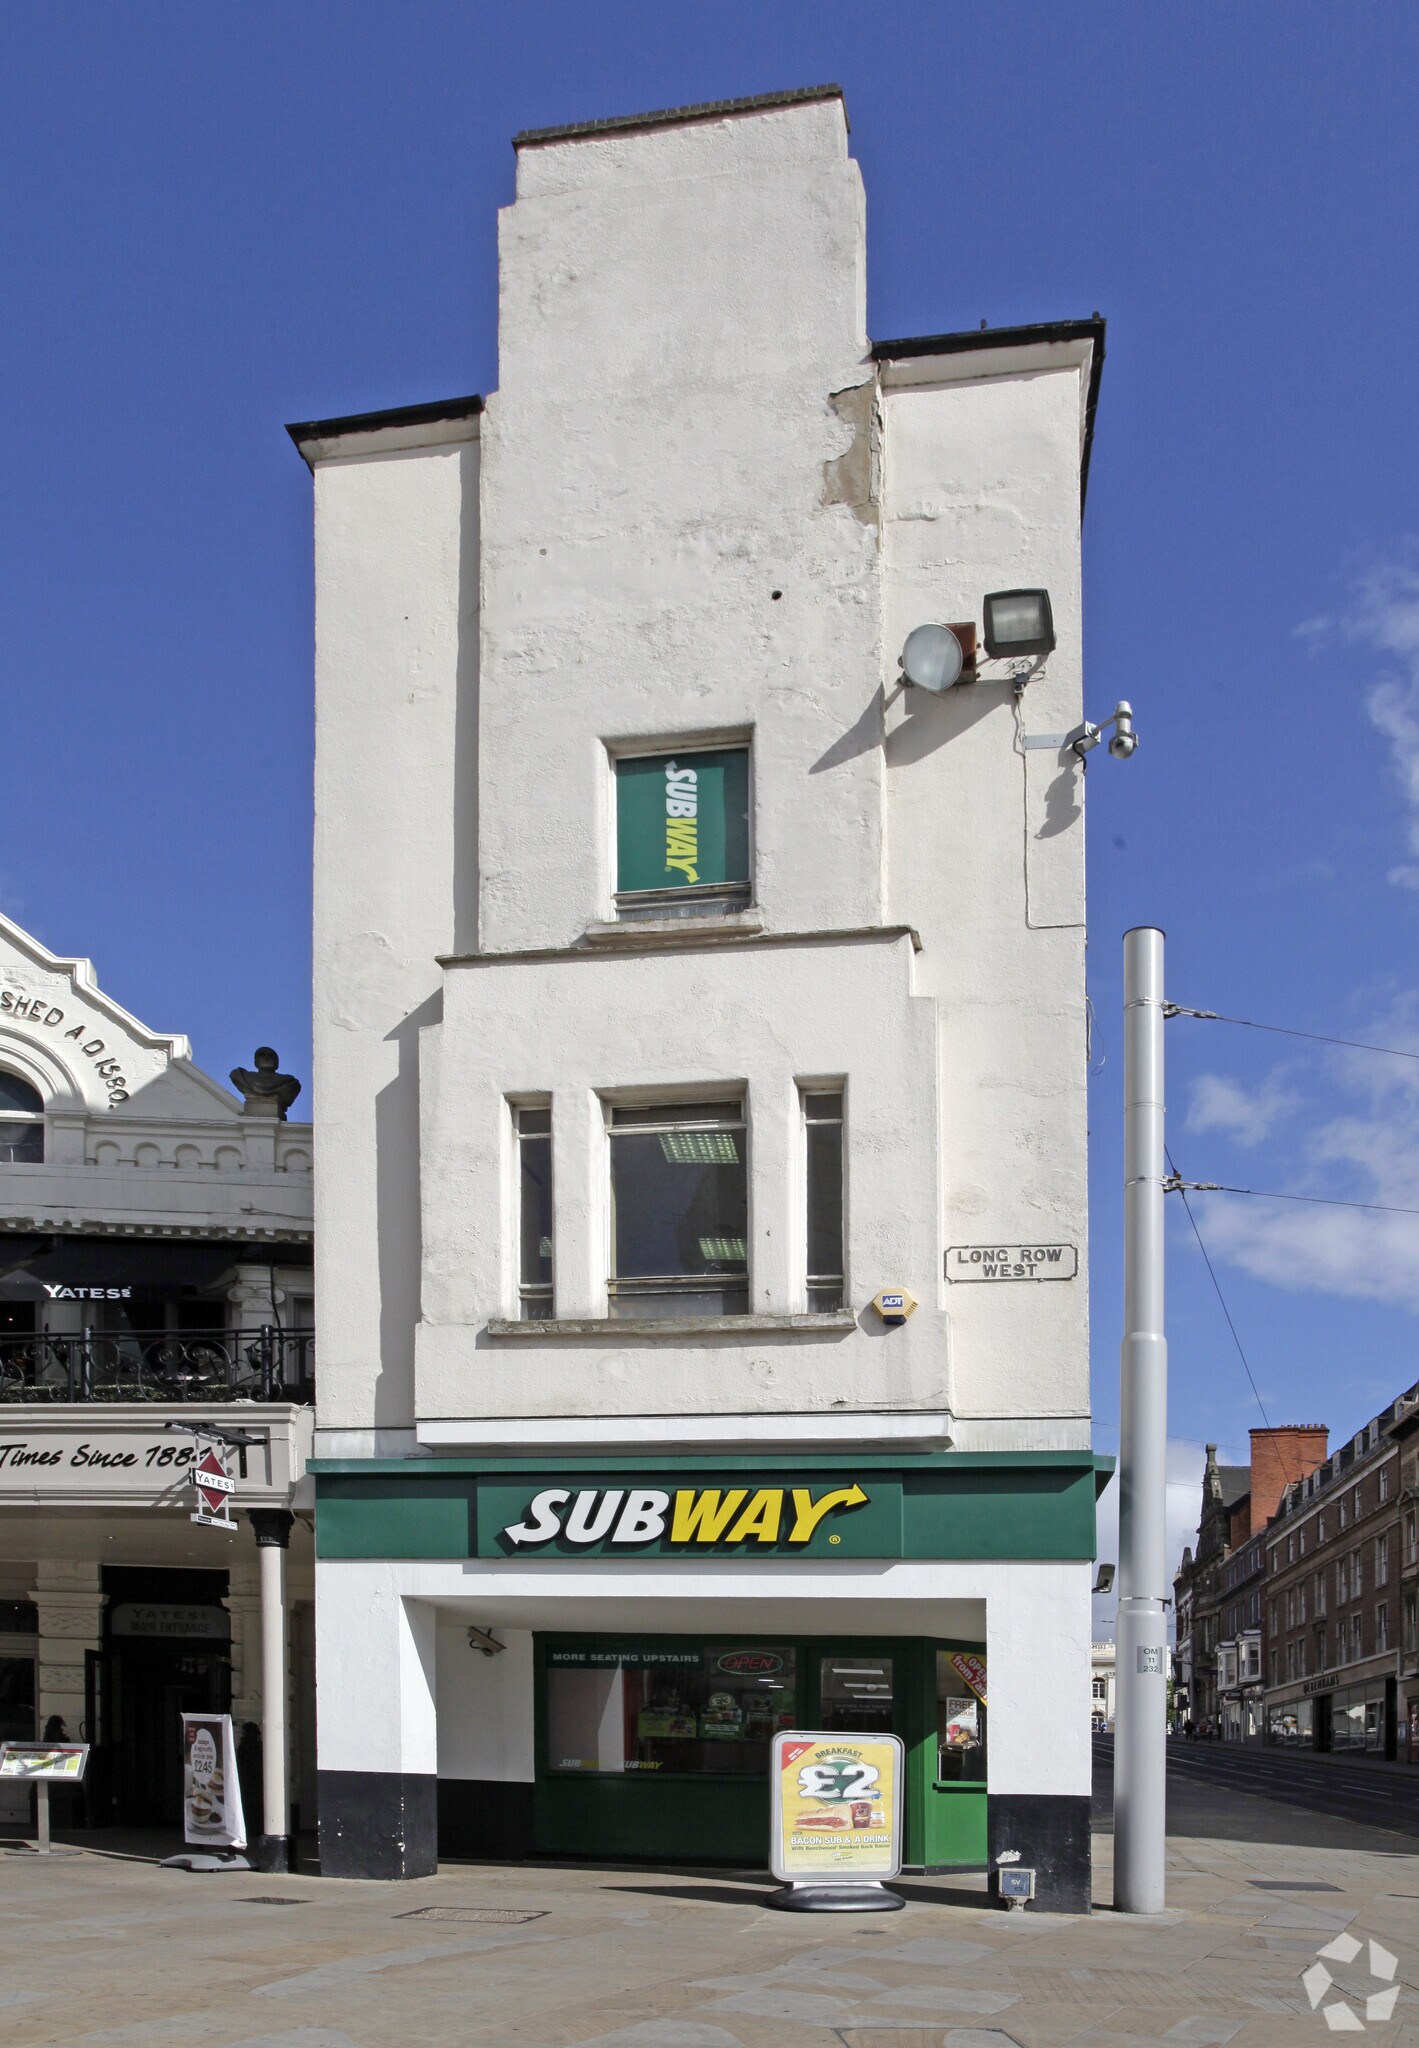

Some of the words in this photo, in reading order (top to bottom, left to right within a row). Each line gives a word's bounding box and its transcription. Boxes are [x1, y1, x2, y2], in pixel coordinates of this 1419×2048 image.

[664, 760, 699, 883] SUBWAY
[957, 1249, 1009, 1264] LONG
[1019, 1248, 1063, 1263] ROW
[982, 1263, 1038, 1278] WEST
[882, 1296, 903, 1306] ADT
[0, 1443, 64, 1468] Times
[70, 1443, 139, 1468] Since
[504, 1484, 871, 1545] SUBWAY
[1143, 1647, 1159, 1655] OM
[552, 1653, 586, 1661] MORE
[590, 1653, 639, 1662] SEATING
[642, 1654, 700, 1663] UPSTAIRS
[725, 1656, 773, 1669] OPEN
[952, 1655, 974, 1680] from
[1143, 1665, 1159, 1673] 232
[948, 1699, 974, 1710] FREE
[948, 1708, 975, 1717] Cookie
[814, 1747, 864, 1760] BREAKFAST
[797, 1764, 880, 1799] £2
[791, 1836, 823, 1845] BACON
[825, 1836, 842, 1844] SUB
[844, 1836, 851, 1844] &
[863, 1834, 890, 1843] DRINK
